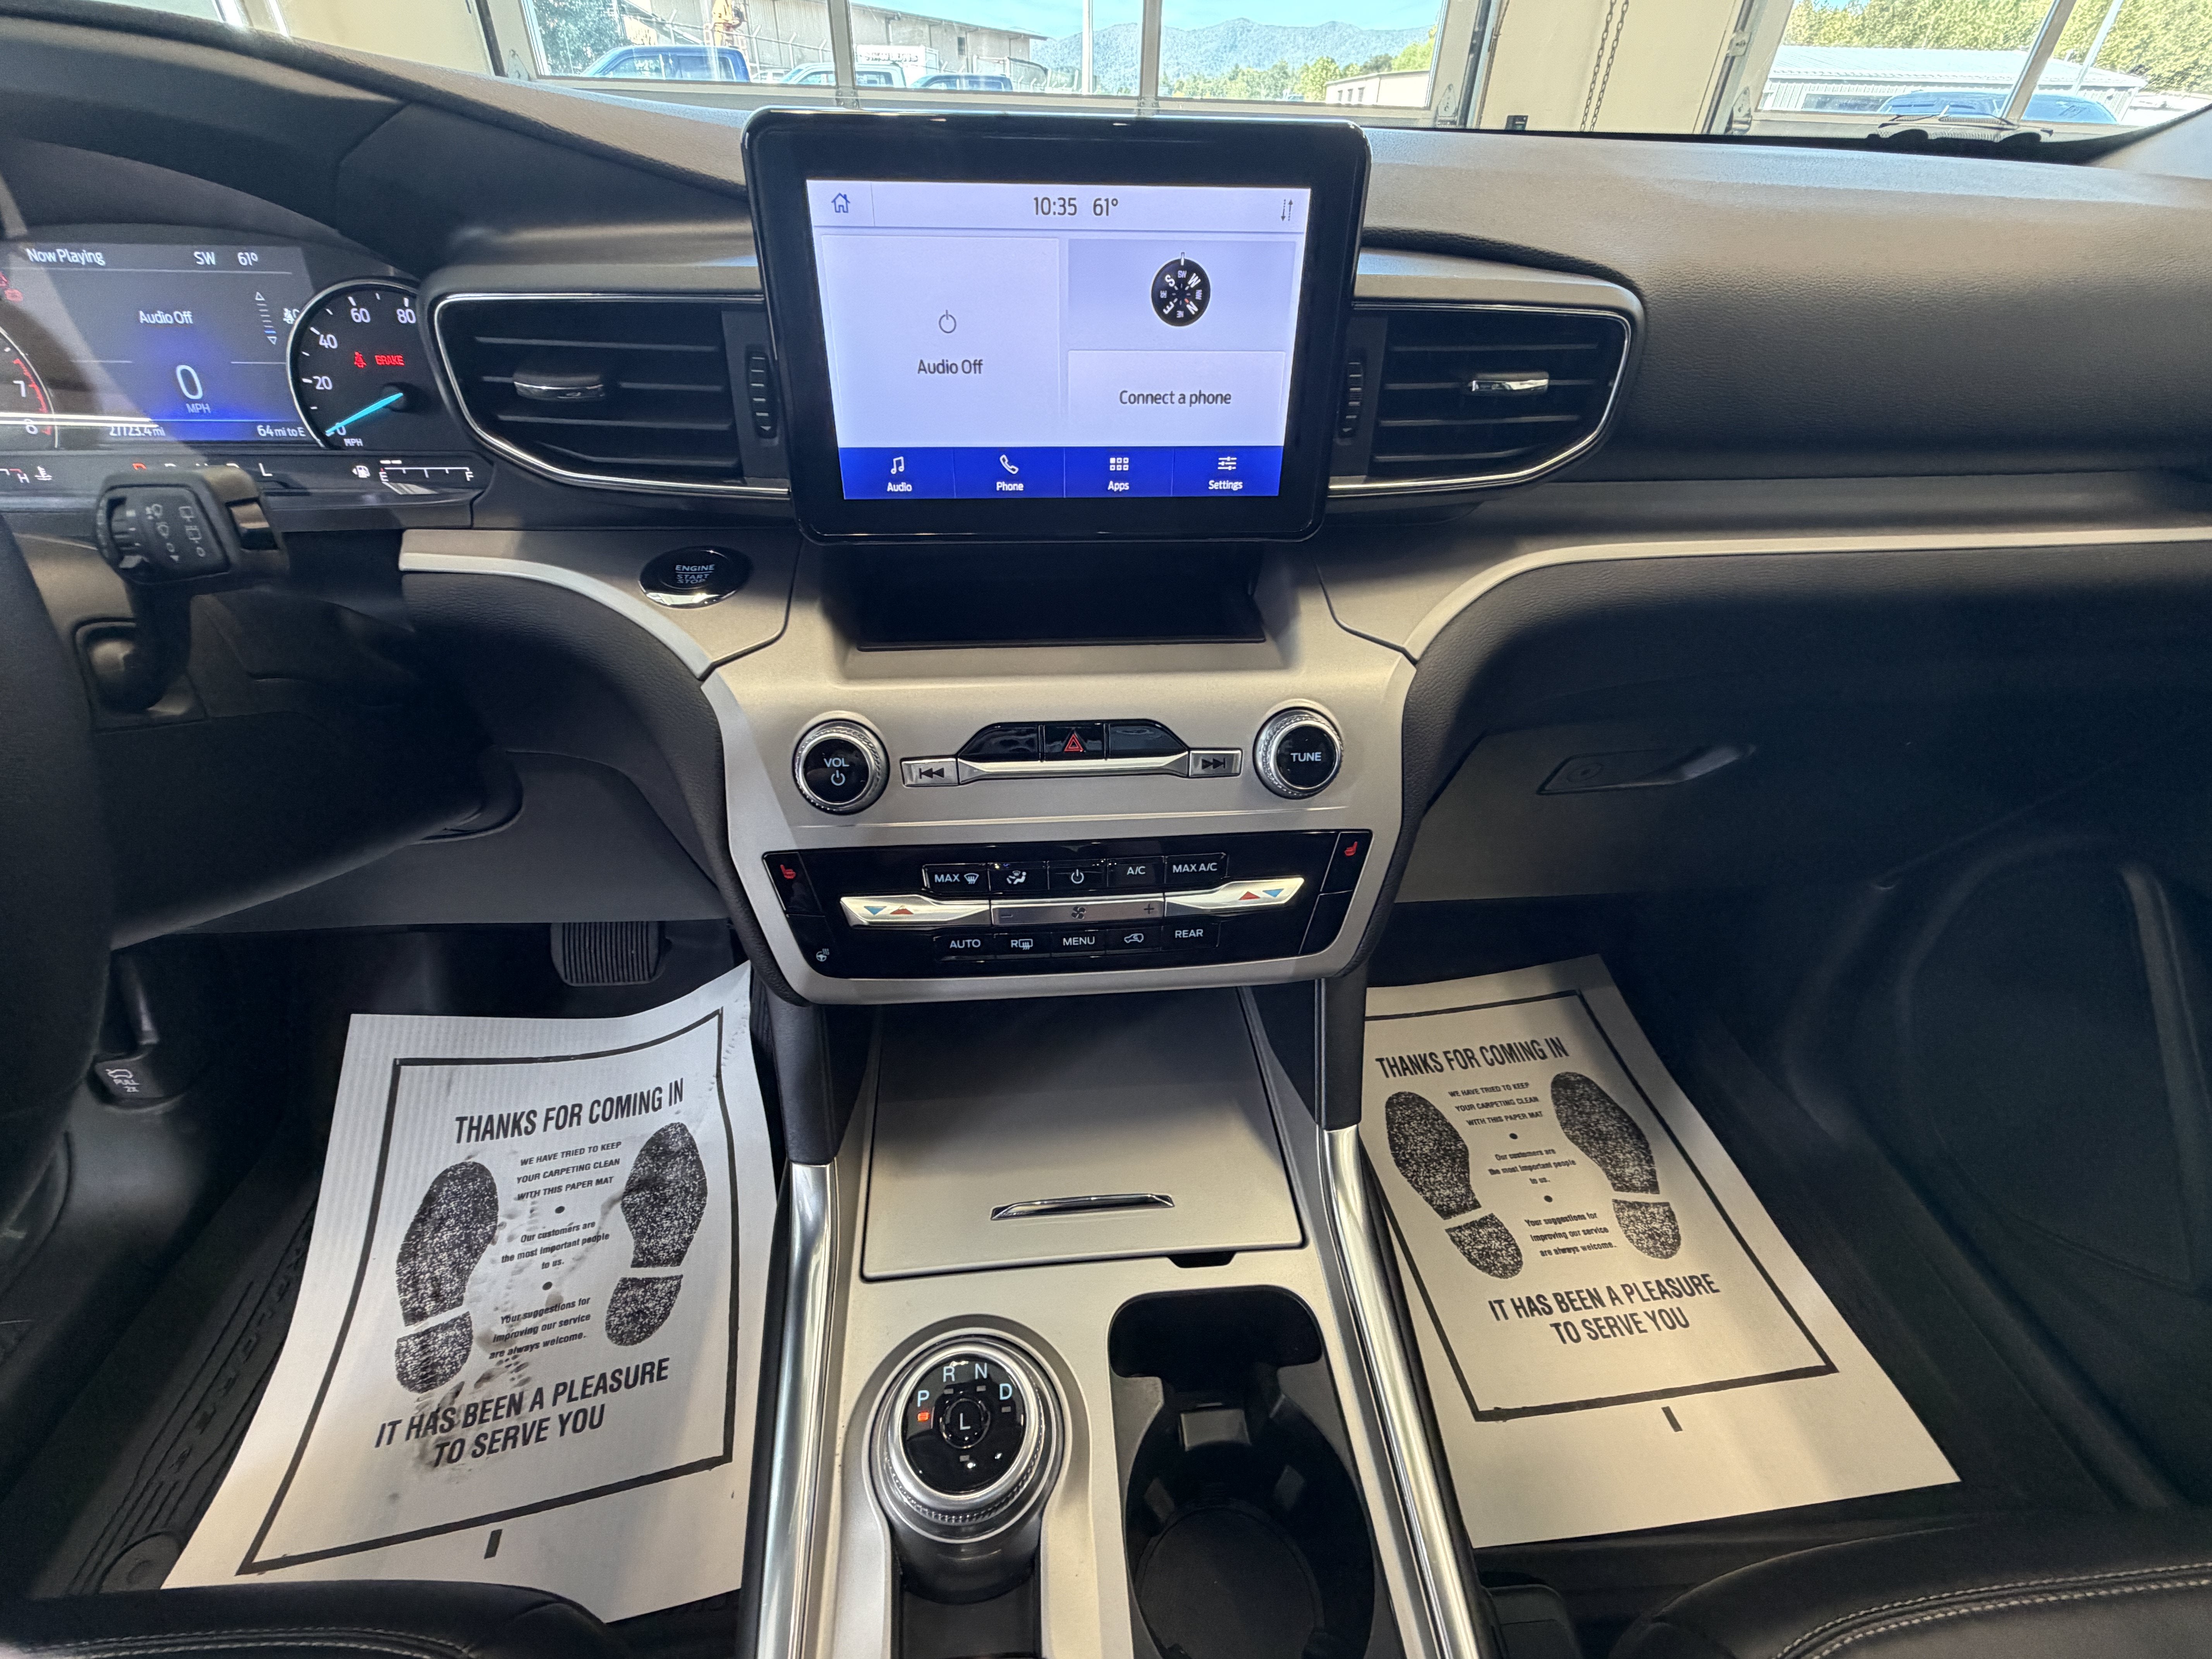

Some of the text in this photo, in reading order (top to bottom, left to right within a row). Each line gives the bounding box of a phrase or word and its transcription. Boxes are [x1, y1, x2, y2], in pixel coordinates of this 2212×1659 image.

[1034, 197, 1119, 216] 10:35 61°
[26, 248, 106, 266] Now Playing
[195, 252, 215, 265] SW
[1165, 275, 1175, 287] S
[1188, 273, 1201, 288] W
[1163, 301, 1175, 314] E
[1186, 301, 1198, 314] N
[139, 311, 193, 324] Audio Off
[351, 308, 370, 323] 60
[397, 309, 416, 323] 80
[319, 334, 338, 349] 40
[375, 355, 404, 366] BRAKE
[917, 359, 983, 374] Audio Off
[13, 380, 26, 397] 7
[176, 365, 203, 399] 0
[315, 376, 332, 390] 20
[1119, 390, 1231, 407] Connect a phone
[186, 404, 211, 414] MPH
[153, 426, 166, 436] mi
[257, 425, 306, 436] 64 mi to E
[258, 463, 273, 476] L
[380, 471, 474, 481] E F
[17, 473, 30, 483] H
[1208, 479, 1243, 490] Settings
[887, 482, 912, 492] Audio
[996, 482, 1024, 492] Phone
[1108, 481, 1130, 492] Apps
[824, 758, 850, 768] VOL
[1290, 752, 1322, 762] TUNE
[1127, 866, 1146, 876] A/C
[1173, 862, 1218, 873] MAX A/C
[934, 874, 960, 883] MAX
[1175, 929, 1204, 938] REAR
[949, 939, 981, 949] AUTO
[1011, 940, 1017, 948] R
[1063, 936, 1095, 946] MENU
[1376, 1037, 1570, 1078] THANKS FOR COMING IN
[455, 1078, 684, 1144] THANKS FOR COMING IN
[1455, 1103, 1476, 1112] YOUR
[1476, 1099, 1515, 1109] CARPETING
[1505, 1113, 1528, 1121] PAPER
[520, 1158, 534, 1166] WE
[536, 1153, 558, 1163] HAVE
[561, 1148, 585, 1158] TRIED
[601, 1142, 622, 1151] KEEP
[517, 1159, 620, 1184] YOUR CARPETING CLEAN
[517, 1176, 614, 1200] WITH THIS PAPER MAT
[1543, 1212, 1586, 1225] suggestions
[520, 1235, 536, 1243] Our
[538, 1225, 580, 1239] customers
[1530, 1231, 1568, 1242] improving
[1582, 1226, 1609, 1235] service
[501, 1233, 610, 1263] the most important people
[1553, 1246, 1580, 1255] always
[1580, 1242, 1617, 1252] welcome.
[1489, 1273, 1720, 1321] IT HAS BEEN A PLEASURE
[501, 1297, 591, 1324] Your suggestions for
[493, 1314, 591, 1343] improving our service
[1549, 1307, 1690, 1344] TO SERVE YOU
[489, 1332, 587, 1359] are always welcome.
[943, 1362, 988, 1382] R N
[917, 1390, 930, 1407] P
[999, 1383, 1013, 1400] D
[374, 1357, 670, 1448] IT HAS BEEN A PLEASURE
[960, 1413, 971, 1430] L
[434, 1405, 605, 1467] TO SERVE YOU
